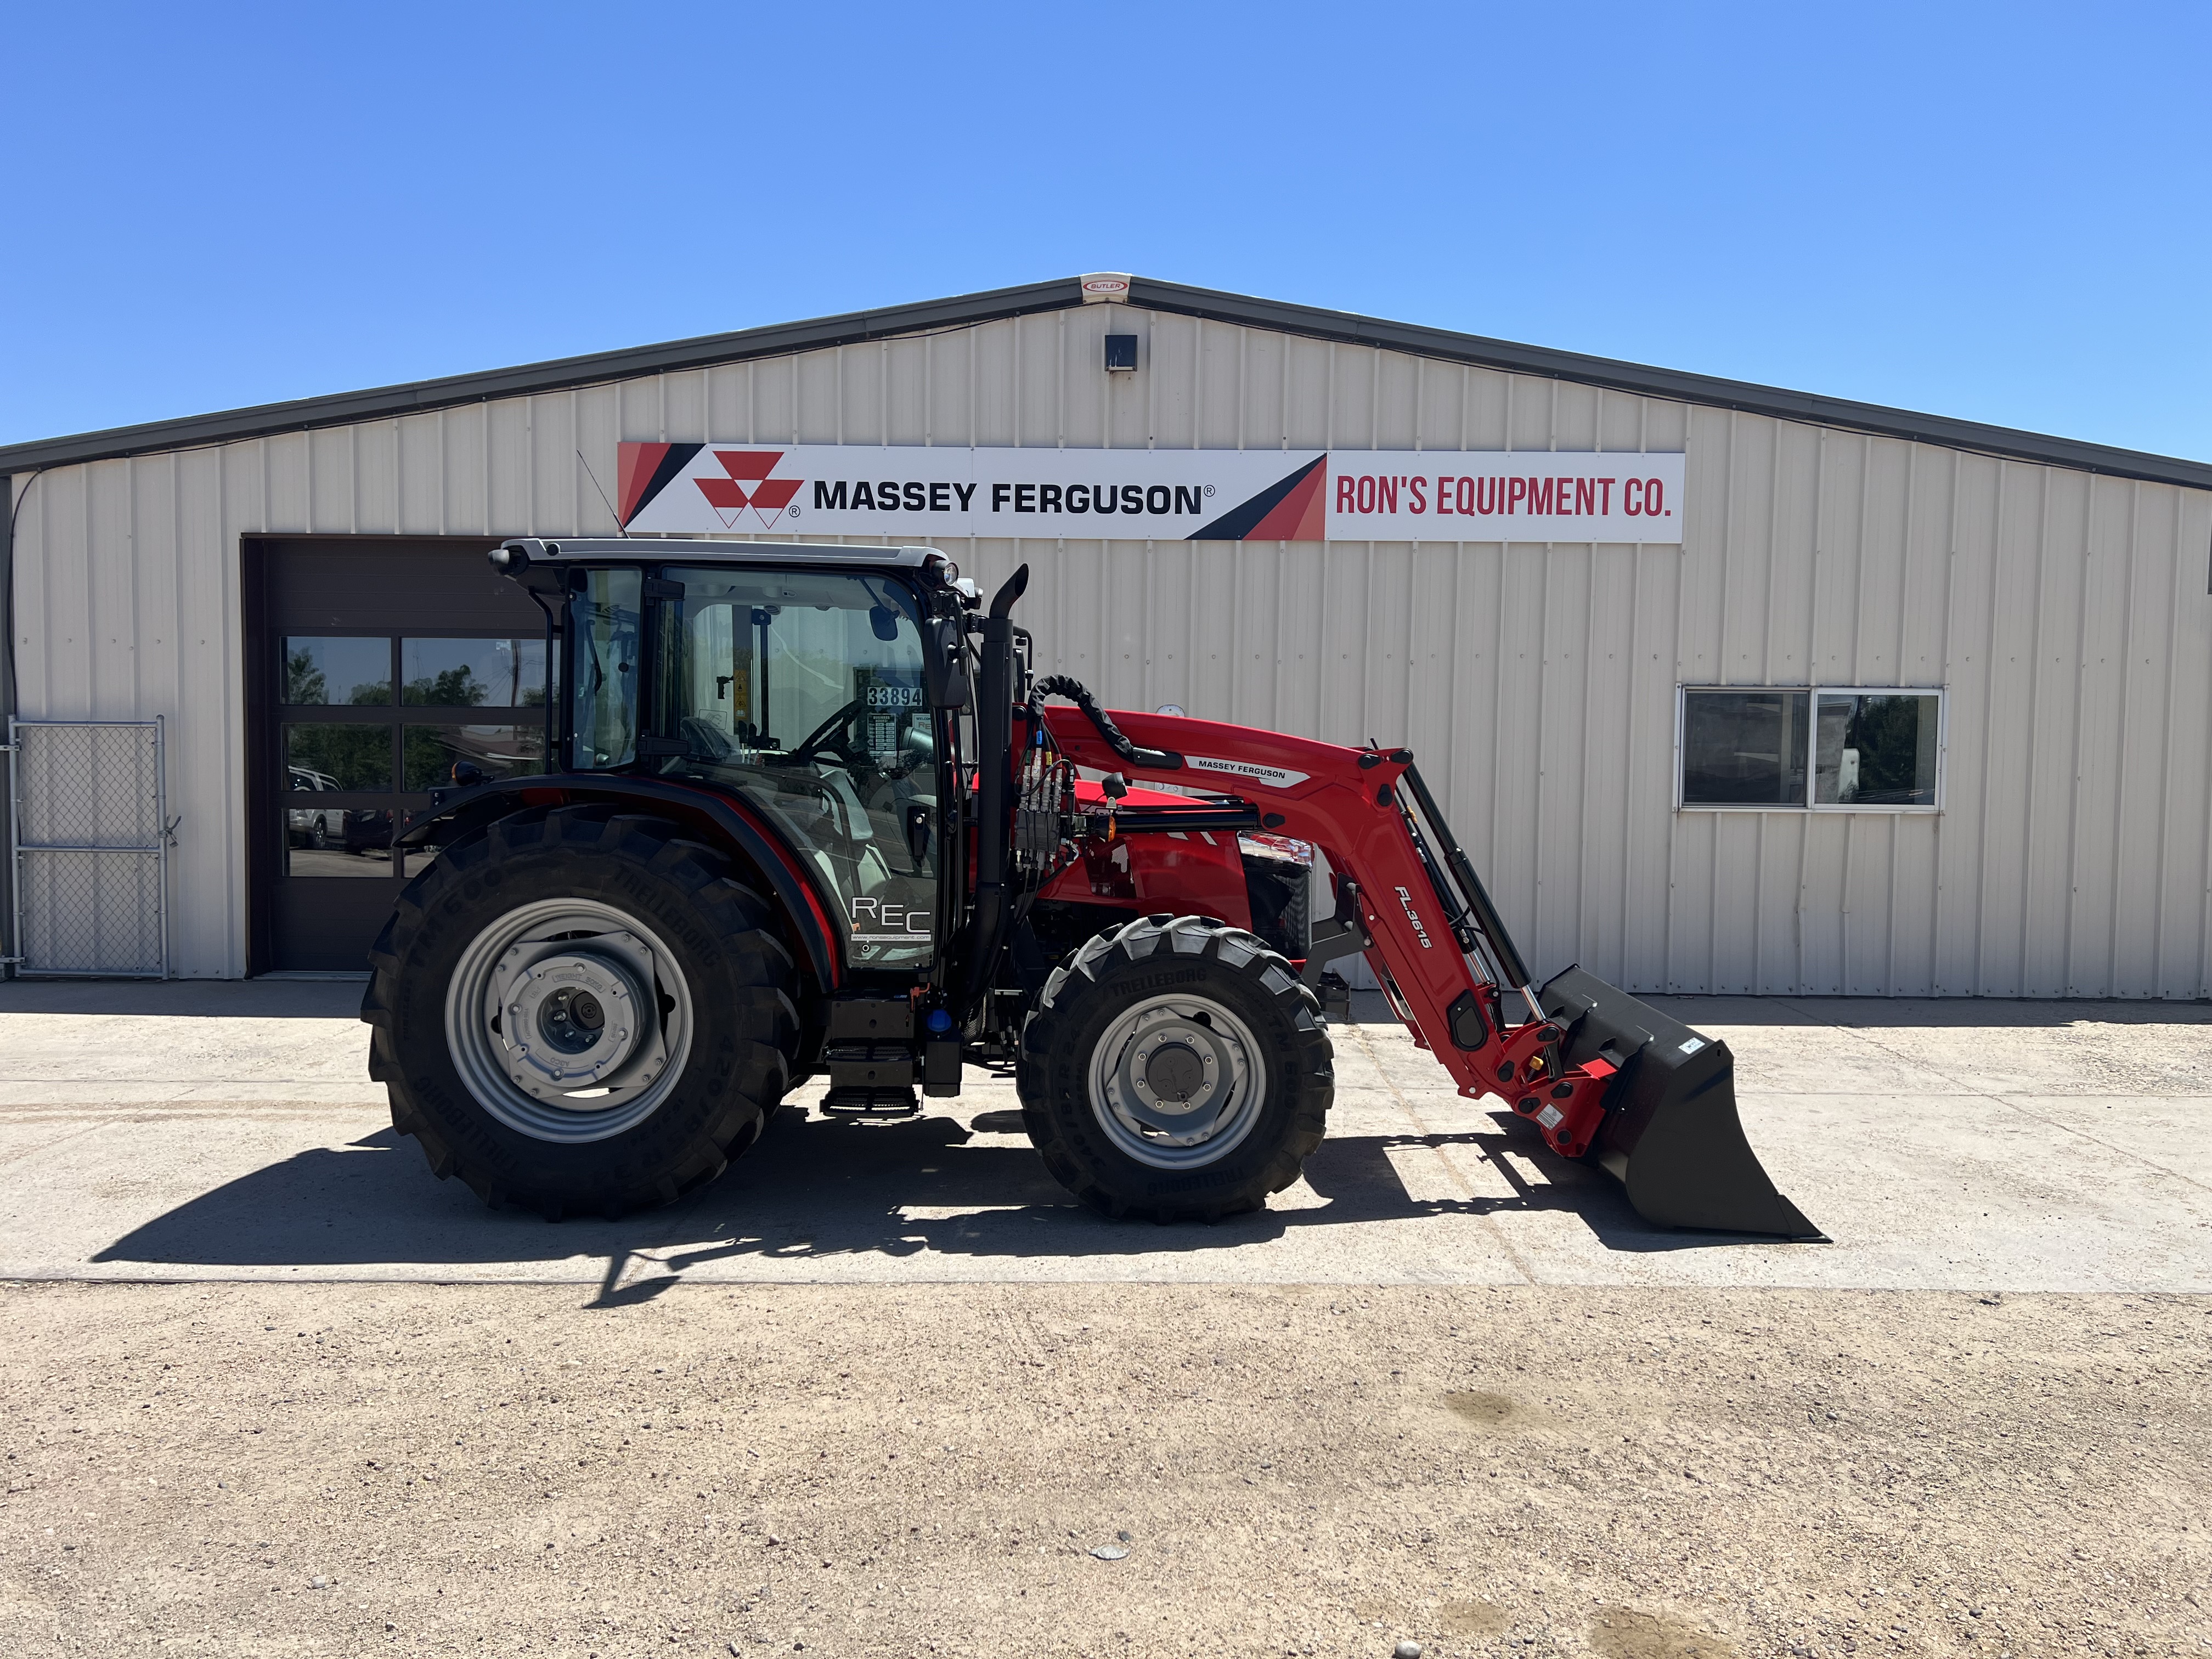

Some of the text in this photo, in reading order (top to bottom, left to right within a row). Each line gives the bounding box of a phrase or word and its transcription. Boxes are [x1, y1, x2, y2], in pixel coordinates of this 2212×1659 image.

[815, 481, 978, 512] MASSEY
[1336, 475, 1672, 516] RON'S EQUIPMENT CO.
[868, 687, 922, 706] 33894
[1198, 760, 1285, 779] MASSEY FERGUSON
[407, 868, 504, 969] TM 600
[613, 864, 722, 968] TRELLEBORG
[851, 896, 931, 933] REC
[555, 973, 583, 981] WEIGHT
[1110, 969, 1207, 996] TRELLEBORG
[550, 1057, 570, 1067] AGCO
